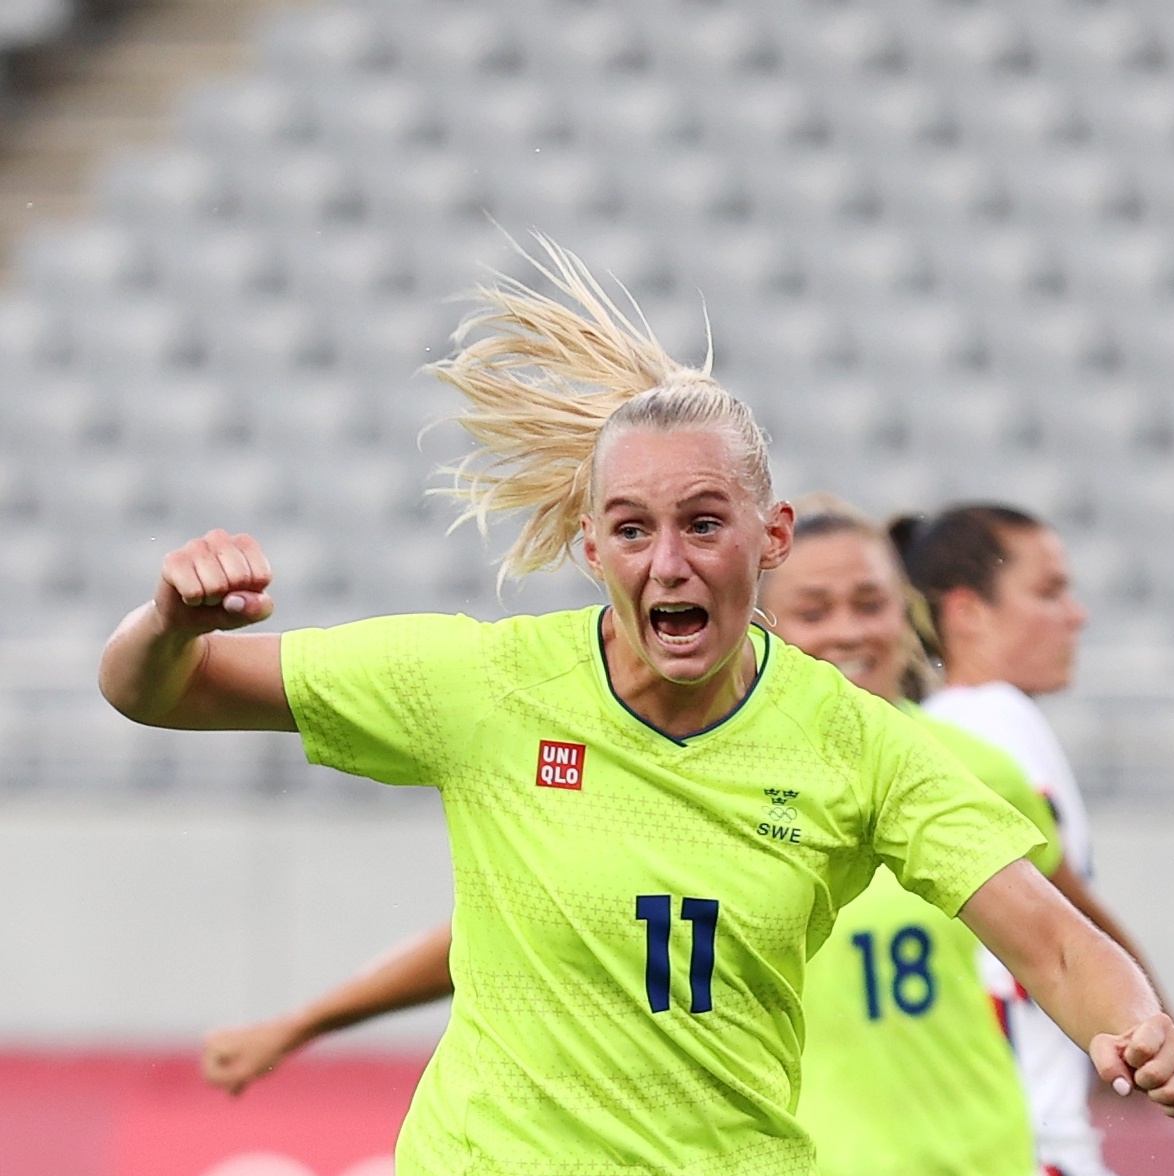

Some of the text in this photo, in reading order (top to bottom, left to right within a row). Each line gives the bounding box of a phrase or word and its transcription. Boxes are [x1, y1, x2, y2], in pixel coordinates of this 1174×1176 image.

[543, 745, 578, 766] UNI
[541, 764, 579, 785] QLO
[756, 822, 801, 844] SWE
[636, 894, 719, 1014] 11
[851, 926, 934, 1021] 18
